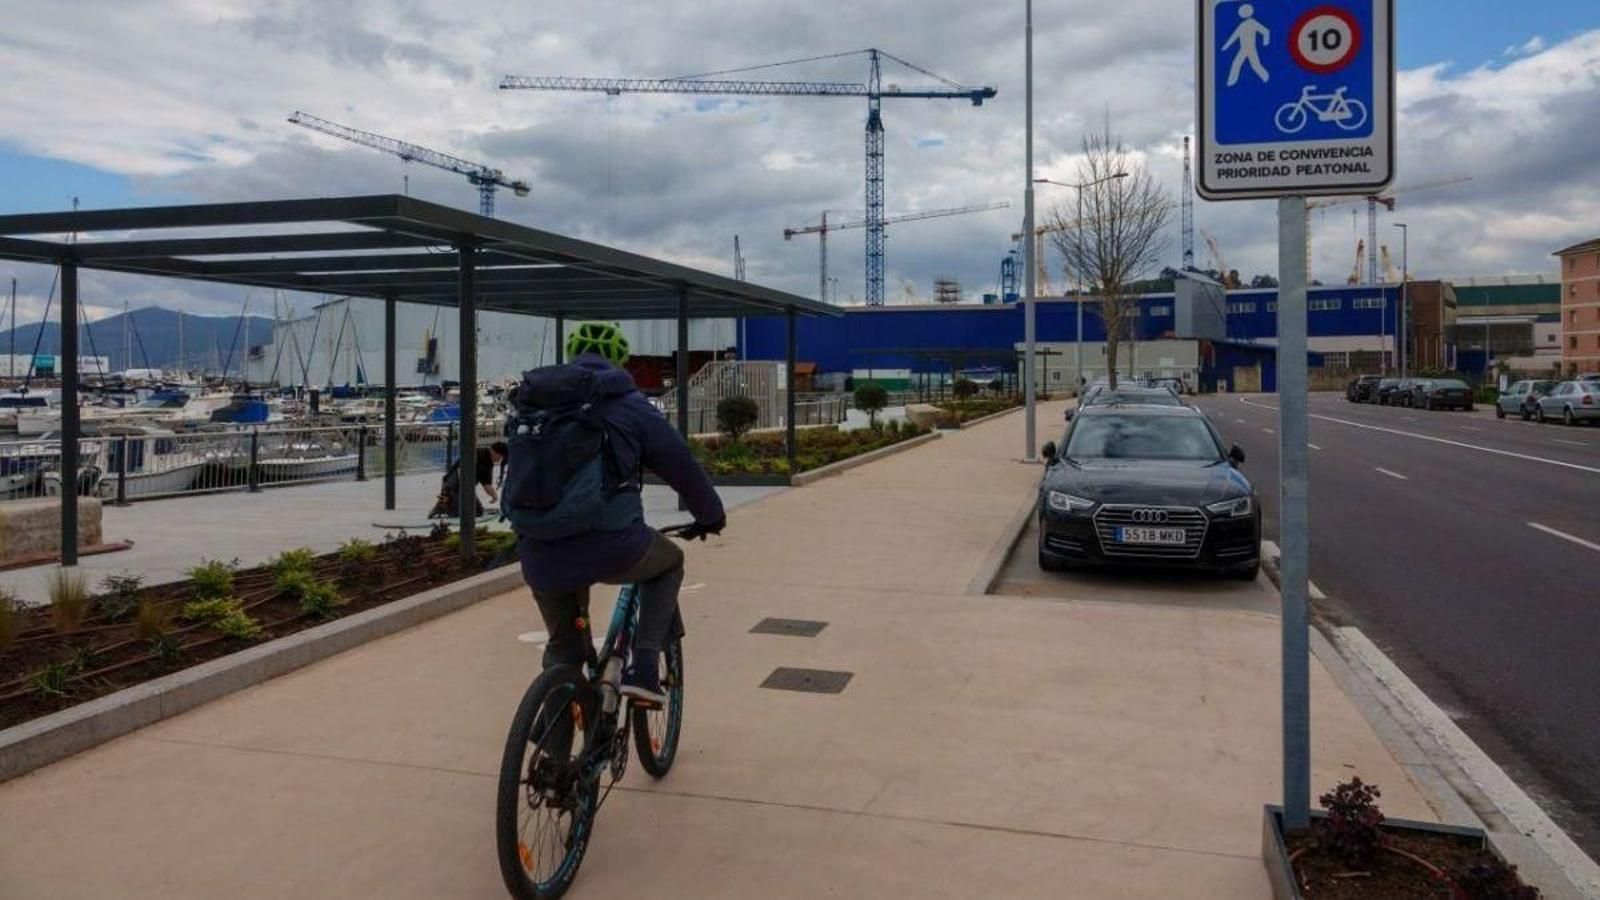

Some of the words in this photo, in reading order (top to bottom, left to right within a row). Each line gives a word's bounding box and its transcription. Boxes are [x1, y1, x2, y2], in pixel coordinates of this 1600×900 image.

[1308, 29, 1341, 51] 10
[1215, 152, 1252, 164] ZONA
[1257, 150, 1275, 162] DE
[1279, 146, 1373, 160] CONVIVENCIA
[1217, 166, 1290, 178] PRIORIDAD
[1296, 162, 1370, 176] PEATONAL
